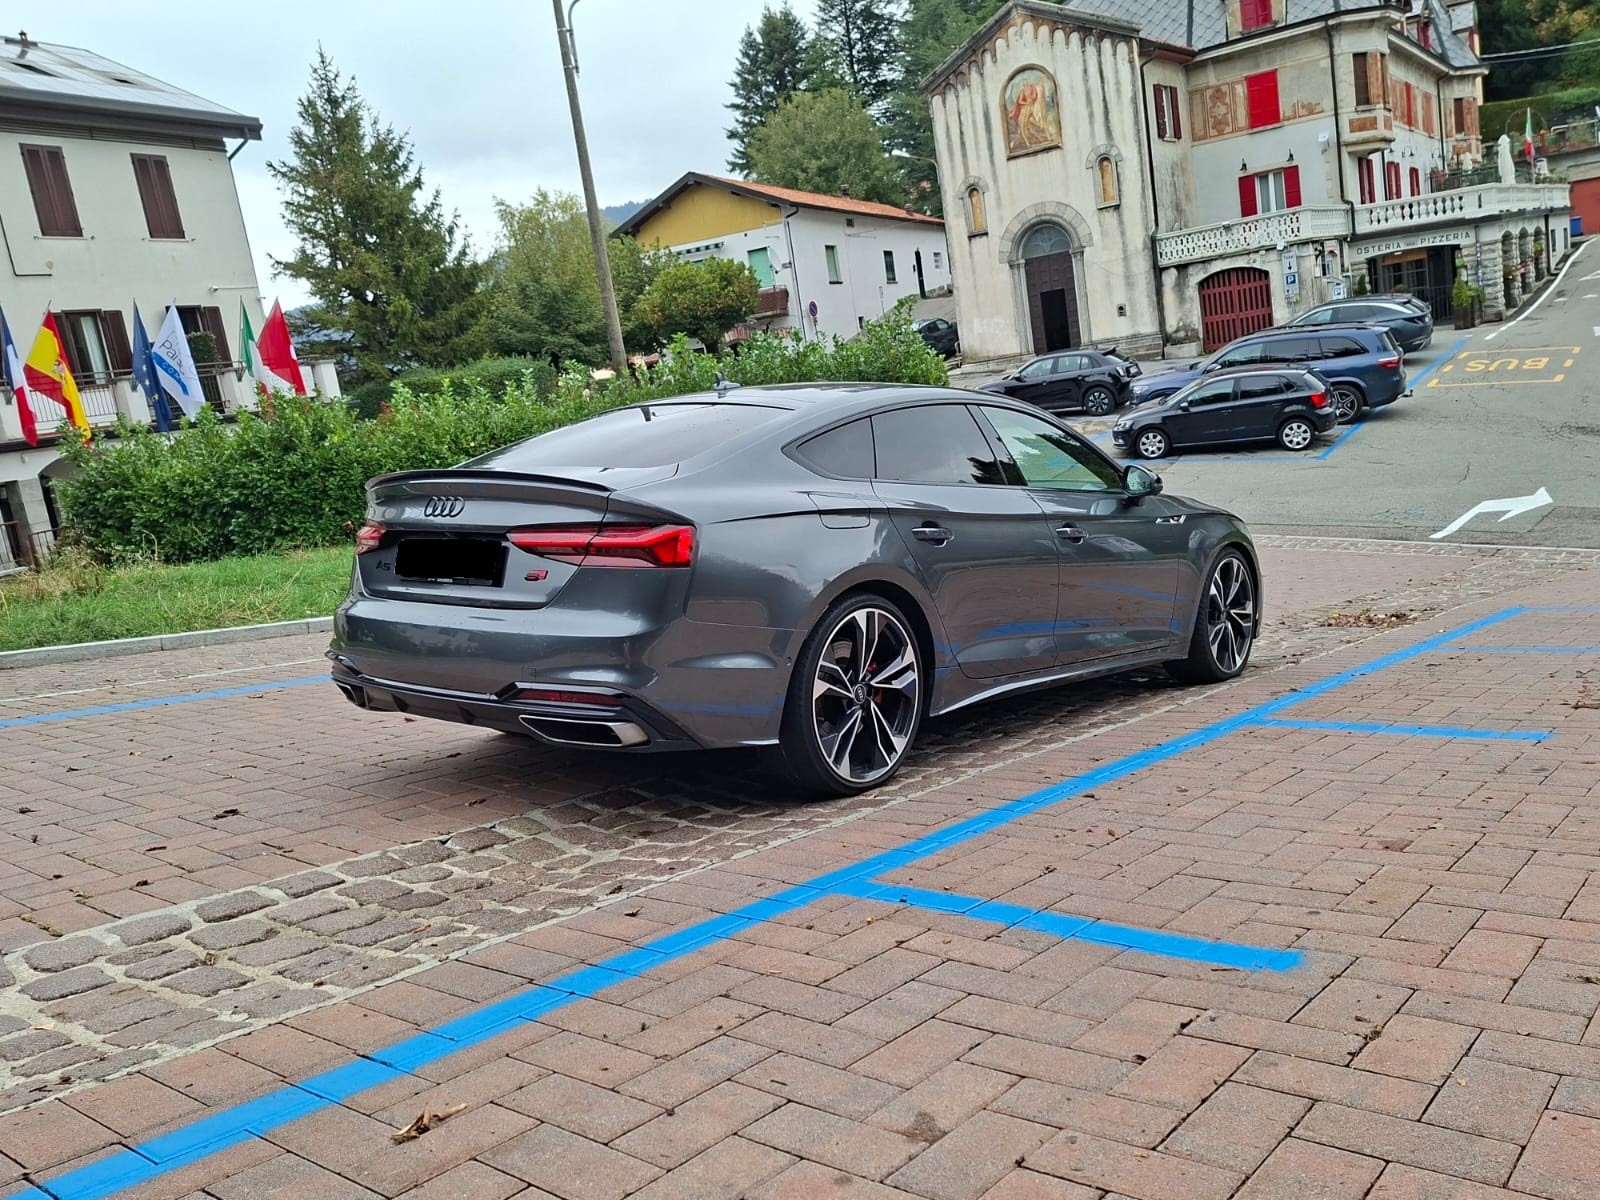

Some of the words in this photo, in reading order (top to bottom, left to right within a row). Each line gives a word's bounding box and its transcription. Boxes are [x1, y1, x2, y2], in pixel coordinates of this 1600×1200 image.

[1356, 242, 1402, 256] OSTERIA
[1420, 231, 1471, 245] PIZZERIA
[1465, 357, 1550, 372] BUS
